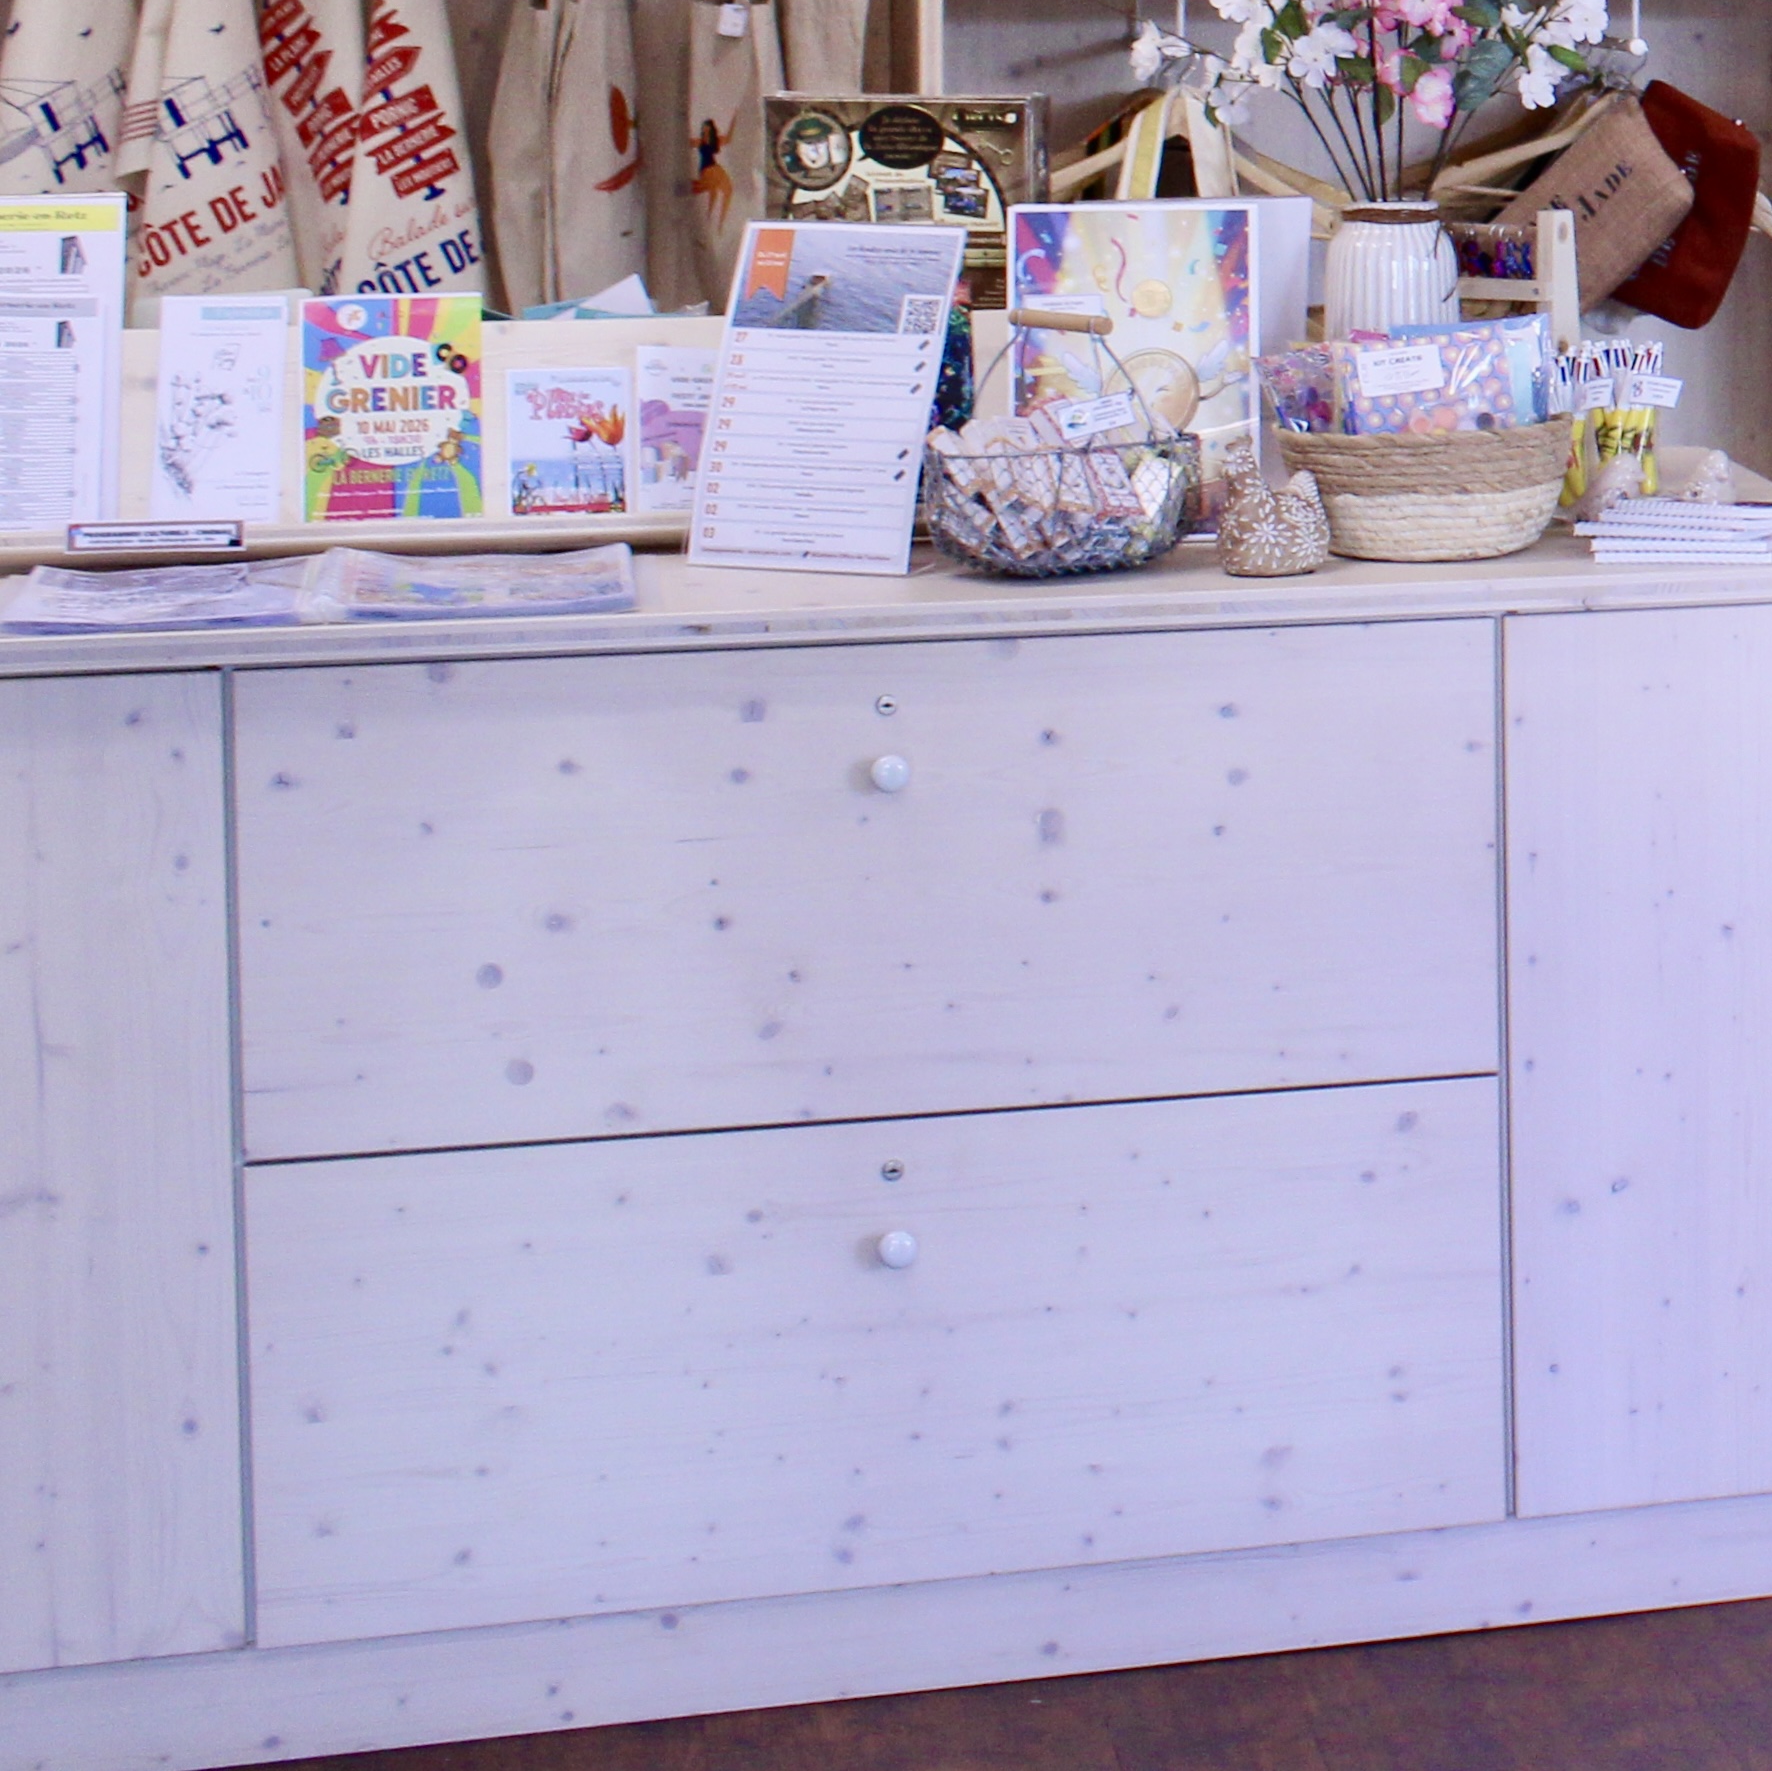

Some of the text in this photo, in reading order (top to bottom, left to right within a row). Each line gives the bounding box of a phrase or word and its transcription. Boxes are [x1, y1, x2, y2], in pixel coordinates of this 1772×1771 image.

[260, 165, 286, 209] JA
[208, 186, 258, 234] DE
[440, 230, 480, 275] DE
[359, 353, 427, 378] VIDE
[326, 385, 457, 414] GRENIER
[356, 418, 430, 434] 10 MAI 2026
[361, 446, 425, 459] LES HALLES
